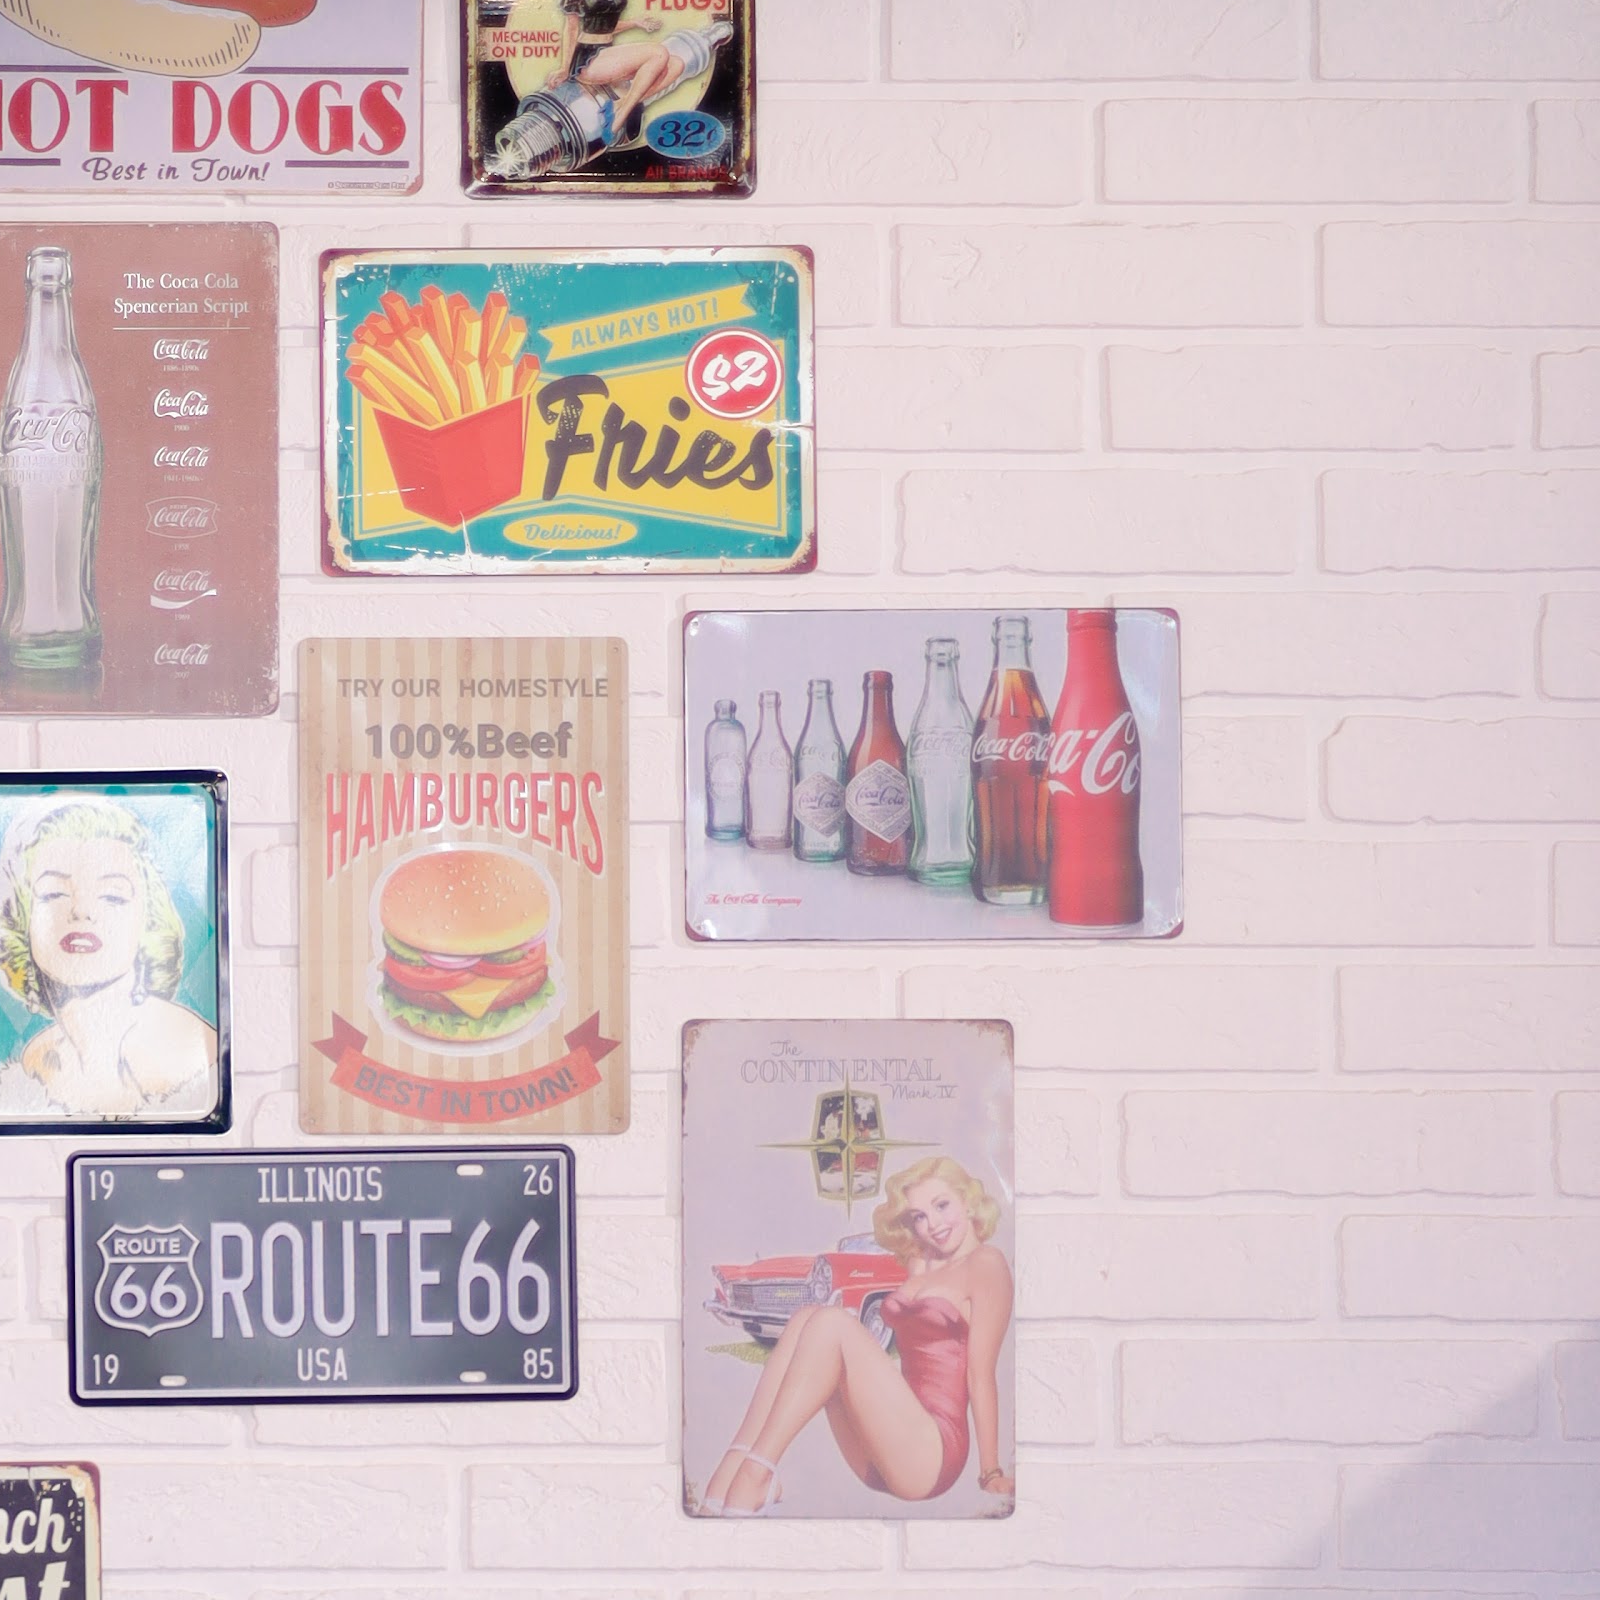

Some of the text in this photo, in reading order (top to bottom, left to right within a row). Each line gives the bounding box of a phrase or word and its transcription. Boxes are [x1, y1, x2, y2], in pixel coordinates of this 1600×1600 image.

[492, 31, 561, 44] MECHANIC
[492, 46, 561, 59] ON DUTY
[171, 79, 408, 155] DOGS
[82, 157, 271, 183] Best in Town!
[123, 273, 154, 289] The
[113, 298, 250, 319] Spencerian Script
[570, 296, 721, 349] ALWAYS HOT!
[702, 349, 769, 401] $2
[535, 373, 775, 502] Fries
[523, 522, 623, 542] Delicious!
[338, 678, 609, 698] TRY OUR HOMESTYLE
[325, 771, 606, 882] HAMBURGERS
[770, 1039, 801, 1057] The
[740, 1058, 942, 1084] CONTINENTAL
[354, 1063, 578, 1118] BEST IN TOWN!
[88, 1164, 554, 1203] 19 ILLINOIS 26
[113, 1236, 181, 1256] ROUTE
[109, 1263, 188, 1319] 66
[92, 1347, 555, 1385] 19 USA 85
